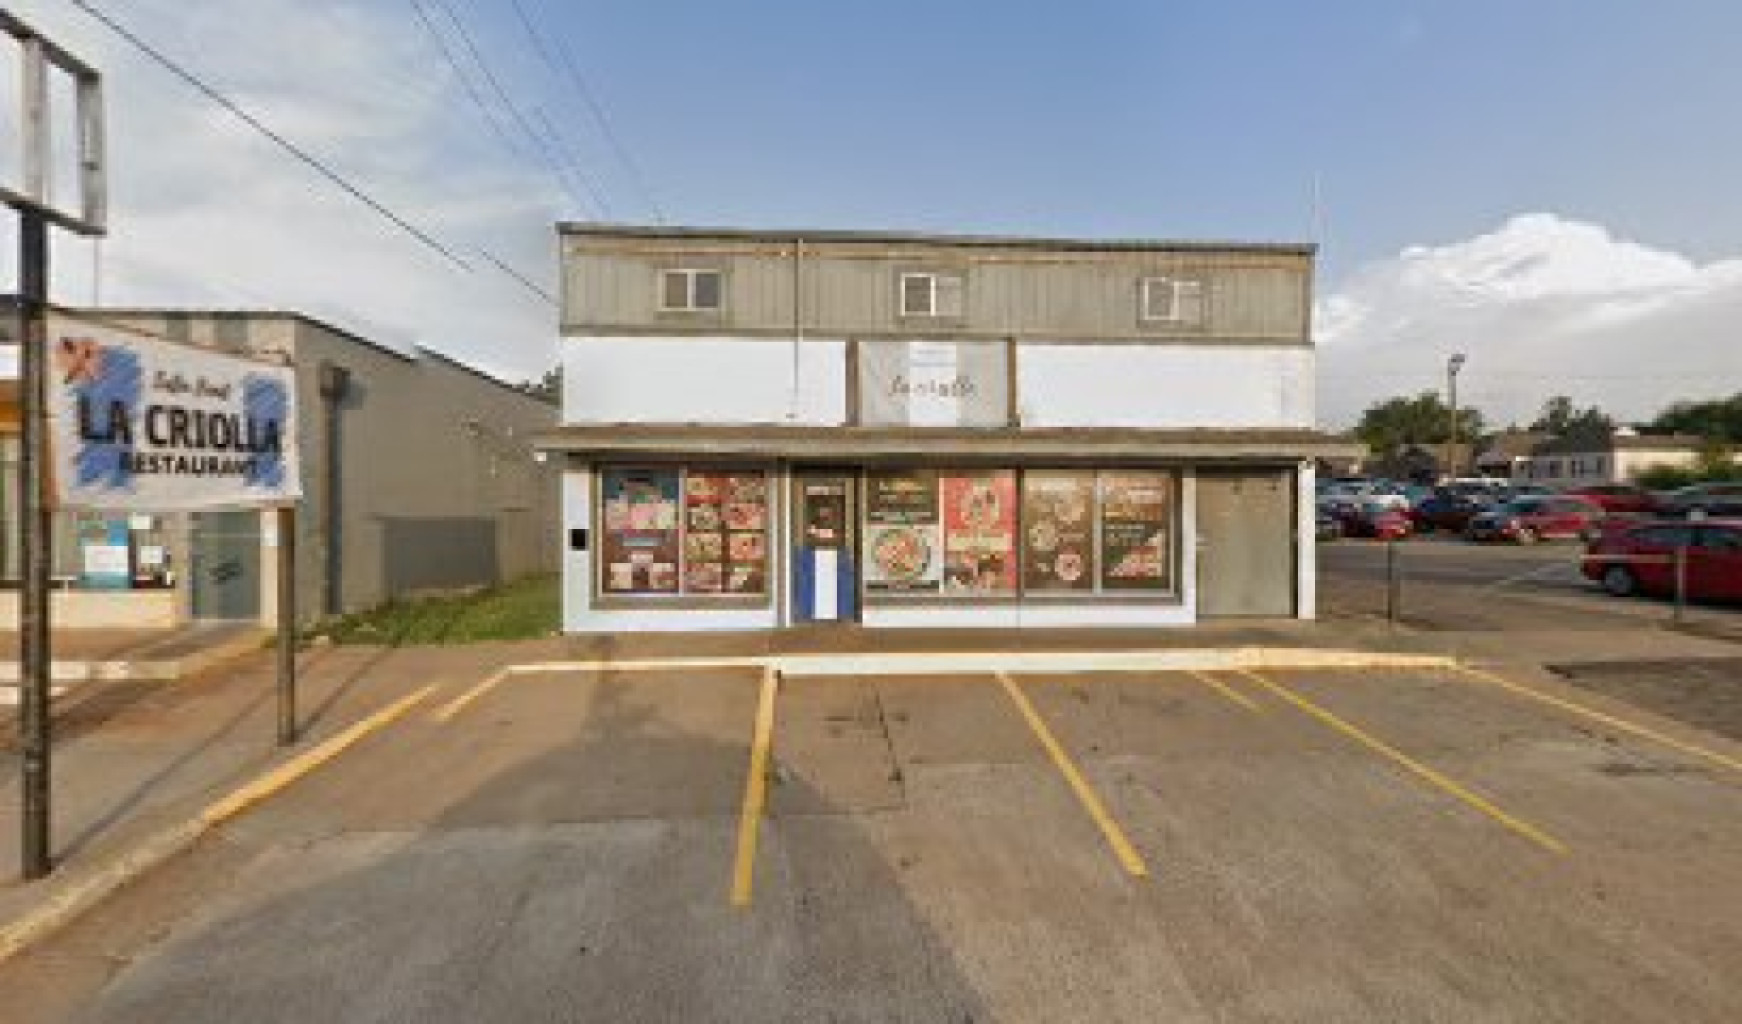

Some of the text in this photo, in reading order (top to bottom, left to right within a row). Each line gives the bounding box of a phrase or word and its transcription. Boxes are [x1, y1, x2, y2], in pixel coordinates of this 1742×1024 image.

[79, 395, 283, 453] LA CRIOLLA
[118, 452, 258, 478] RESTAURANT
